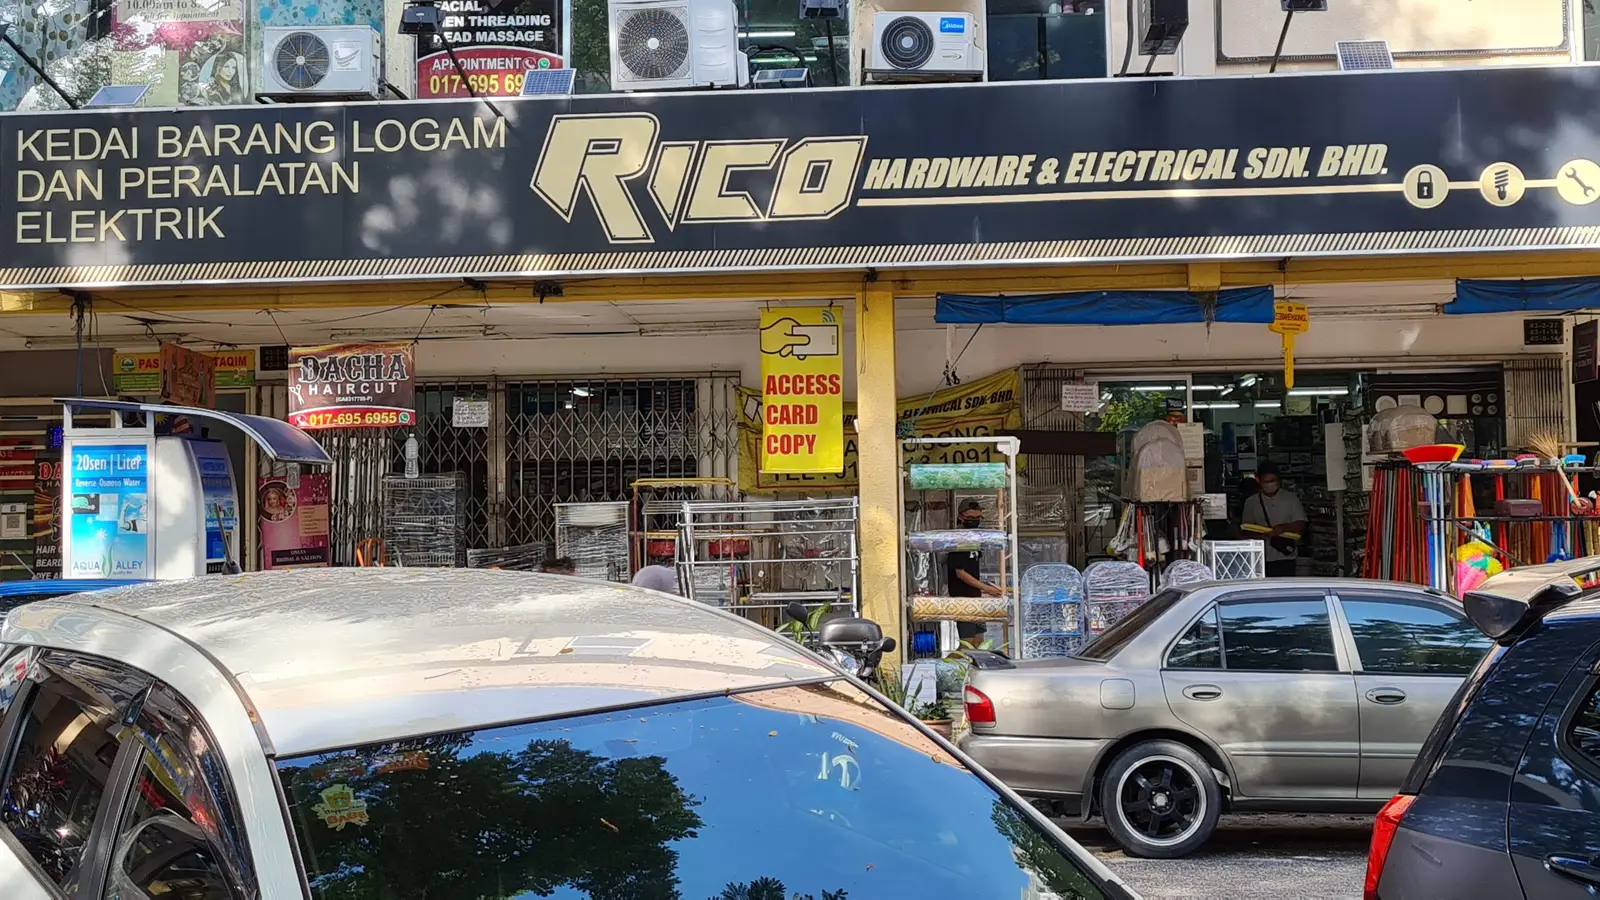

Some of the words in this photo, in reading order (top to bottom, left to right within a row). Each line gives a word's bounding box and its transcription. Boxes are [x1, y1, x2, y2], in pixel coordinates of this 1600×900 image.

[468, 15, 551, 27] THREADING
[476, 31, 544, 42] MASSAGE
[17, 126, 139, 161] KEDAI
[157, 121, 336, 158] BARANG
[353, 116, 507, 153] LOGAM
[863, 154, 1036, 190] HARDWARE
[1037, 157, 1060, 184] &
[1064, 148, 1238, 184] ELECTRICAL
[1243, 145, 1310, 179] SDN.
[1316, 143, 1388, 176] BHD.
[17, 169, 104, 202] DAN
[119, 162, 360, 199] PERALATAN
[529, 111, 869, 244] RICO
[16, 206, 226, 243] ELEKTRIK
[299, 354, 409, 383] DACHA
[308, 382, 398, 396] HAIRCUT
[766, 374, 841, 396] ACCESS
[309, 414, 362, 425] 017-695
[365, 413, 397, 424] 6955
[767, 404, 818, 425] CARD
[767, 434, 816, 455] COPY
[76, 454, 107, 471] 20sen
[75, 478, 97, 488] Reverse
[99, 477, 122, 487] Osmosis
[123, 477, 141, 487] Water
[36, 546, 56, 554] HAIR
[73, 561, 100, 571] AQUA
[116, 560, 143, 570] ALLEY
